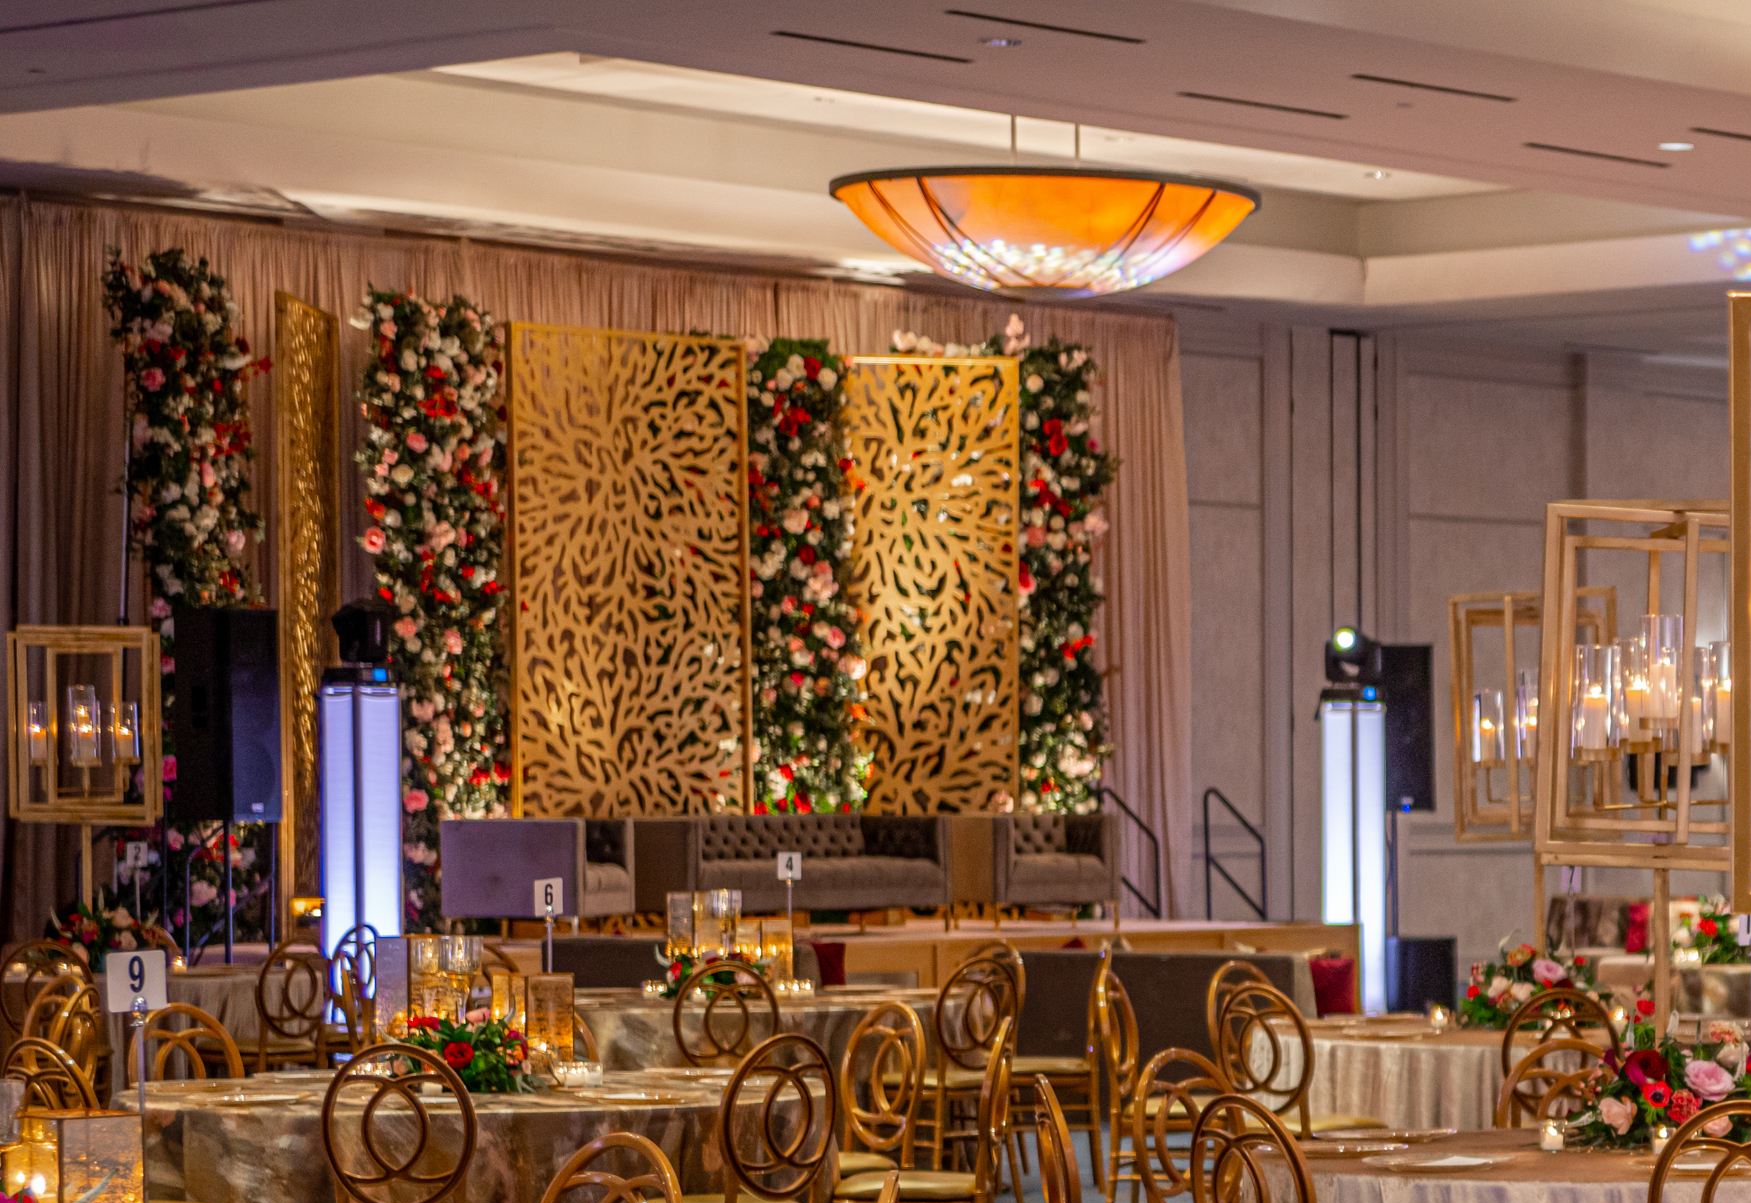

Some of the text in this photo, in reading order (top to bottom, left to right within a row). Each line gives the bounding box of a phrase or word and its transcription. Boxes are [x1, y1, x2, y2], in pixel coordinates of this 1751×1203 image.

[786, 856, 793, 871] 4
[545, 884, 553, 906] 6
[128, 956, 145, 993] 9
